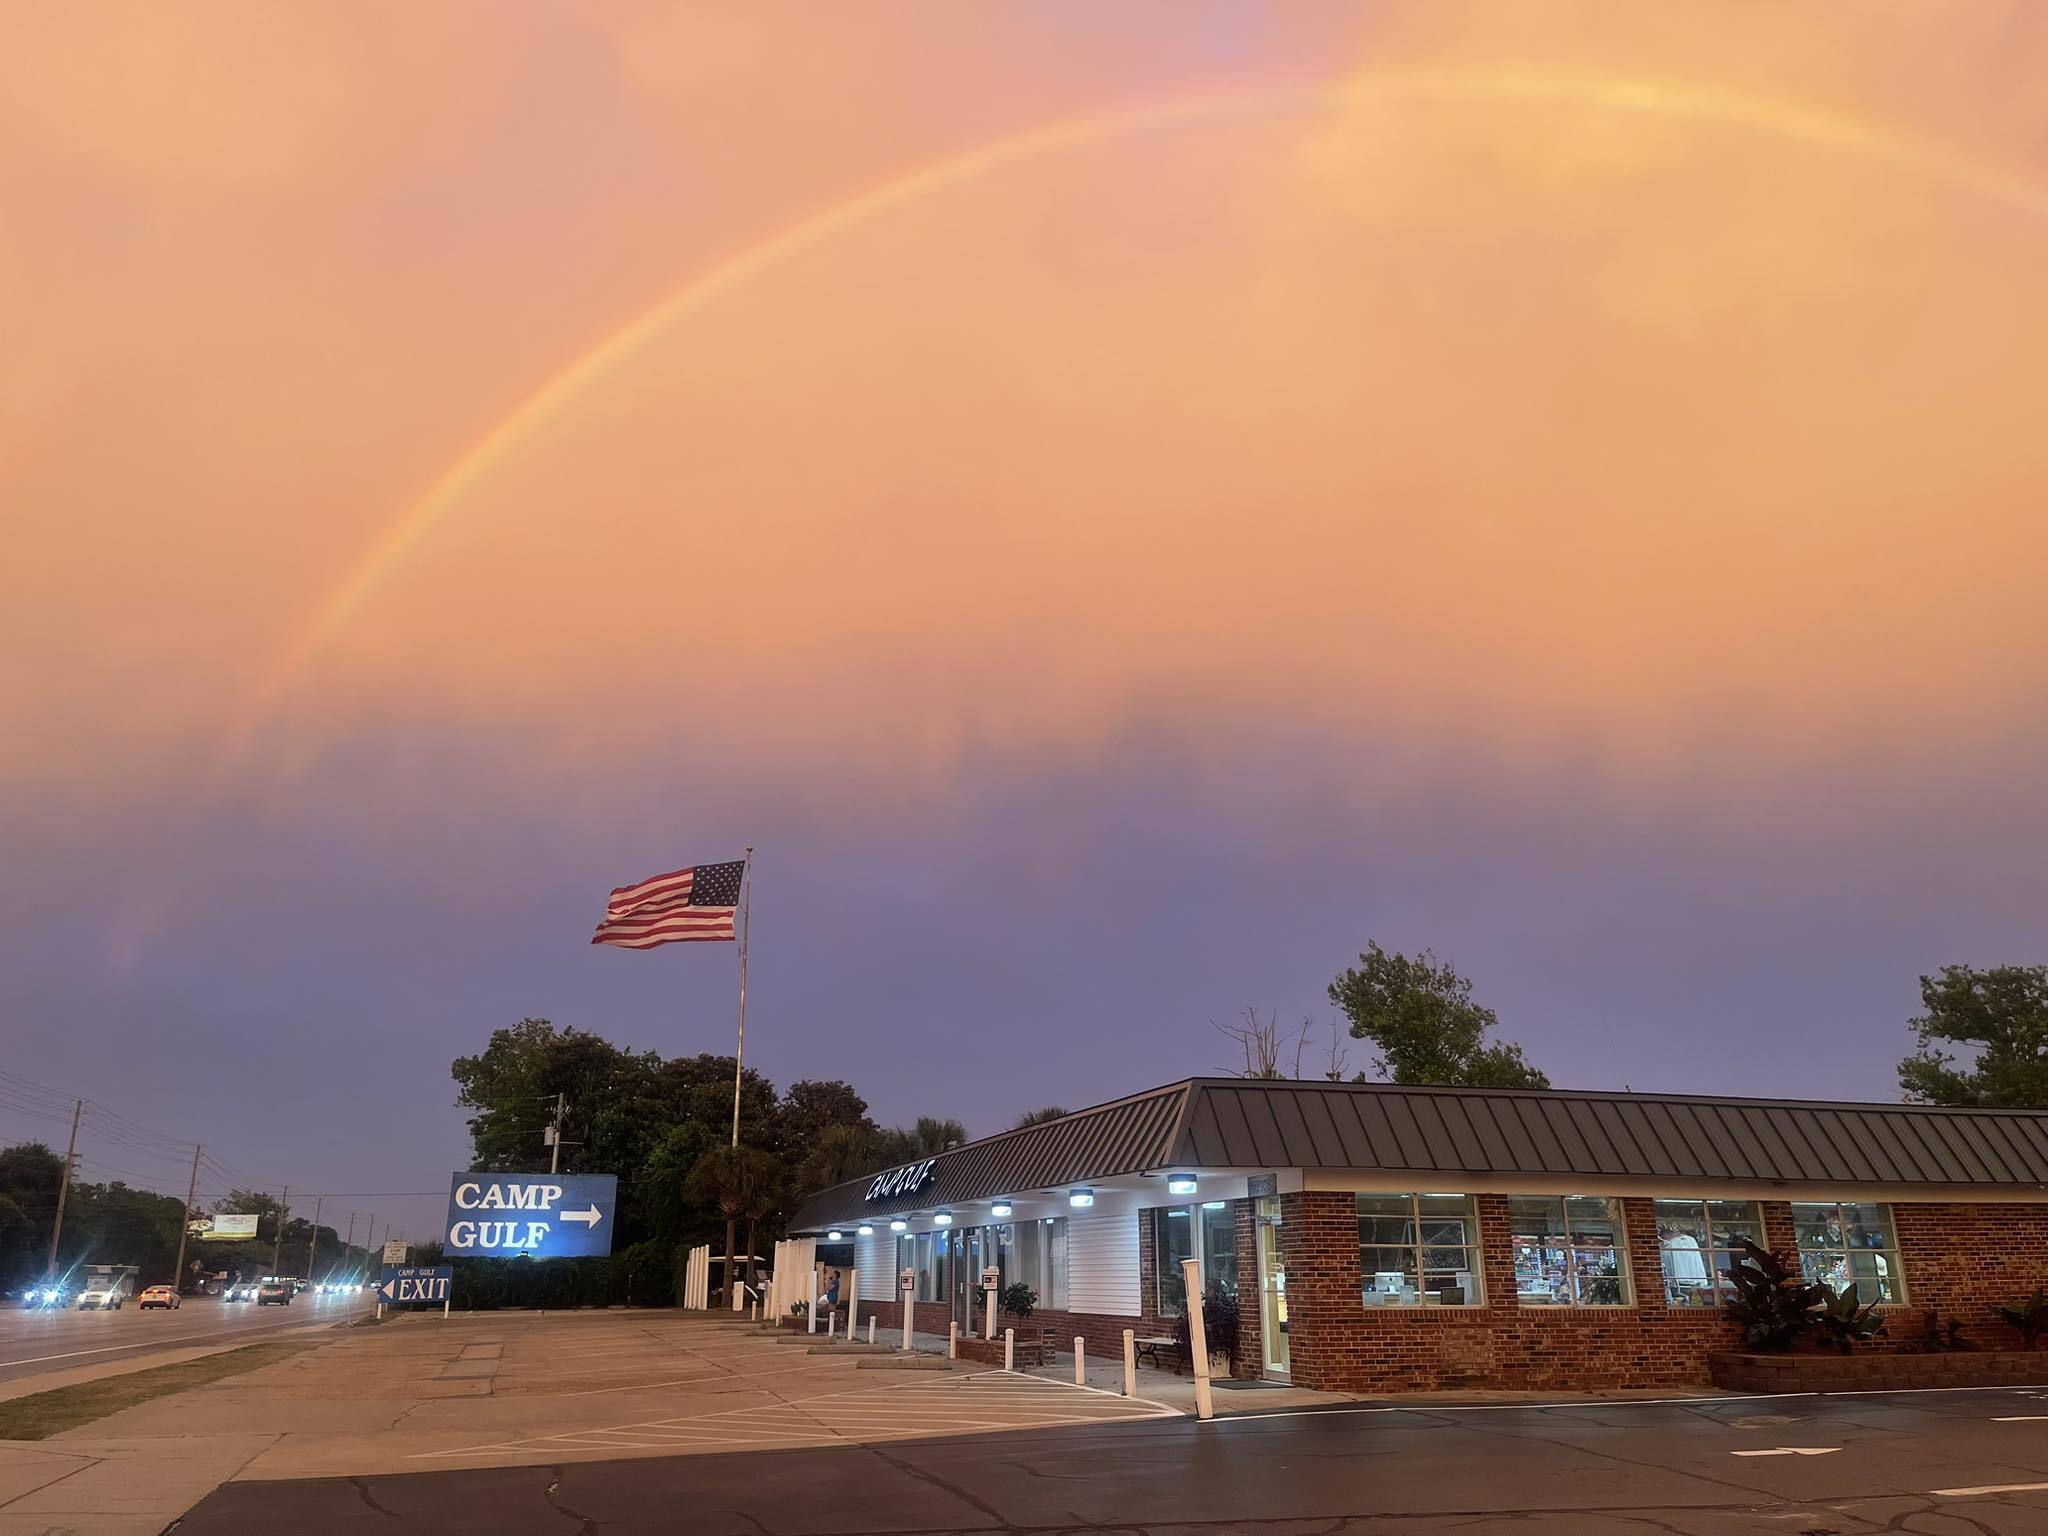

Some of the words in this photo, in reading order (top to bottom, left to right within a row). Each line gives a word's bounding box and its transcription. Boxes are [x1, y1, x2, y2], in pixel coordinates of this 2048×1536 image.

[455, 1182, 563, 1210] CAMP
[450, 1220, 551, 1249] GULF
[398, 1268, 416, 1277] CAMP
[419, 1268, 436, 1277] GULF
[398, 1277, 449, 1301] EXIT
